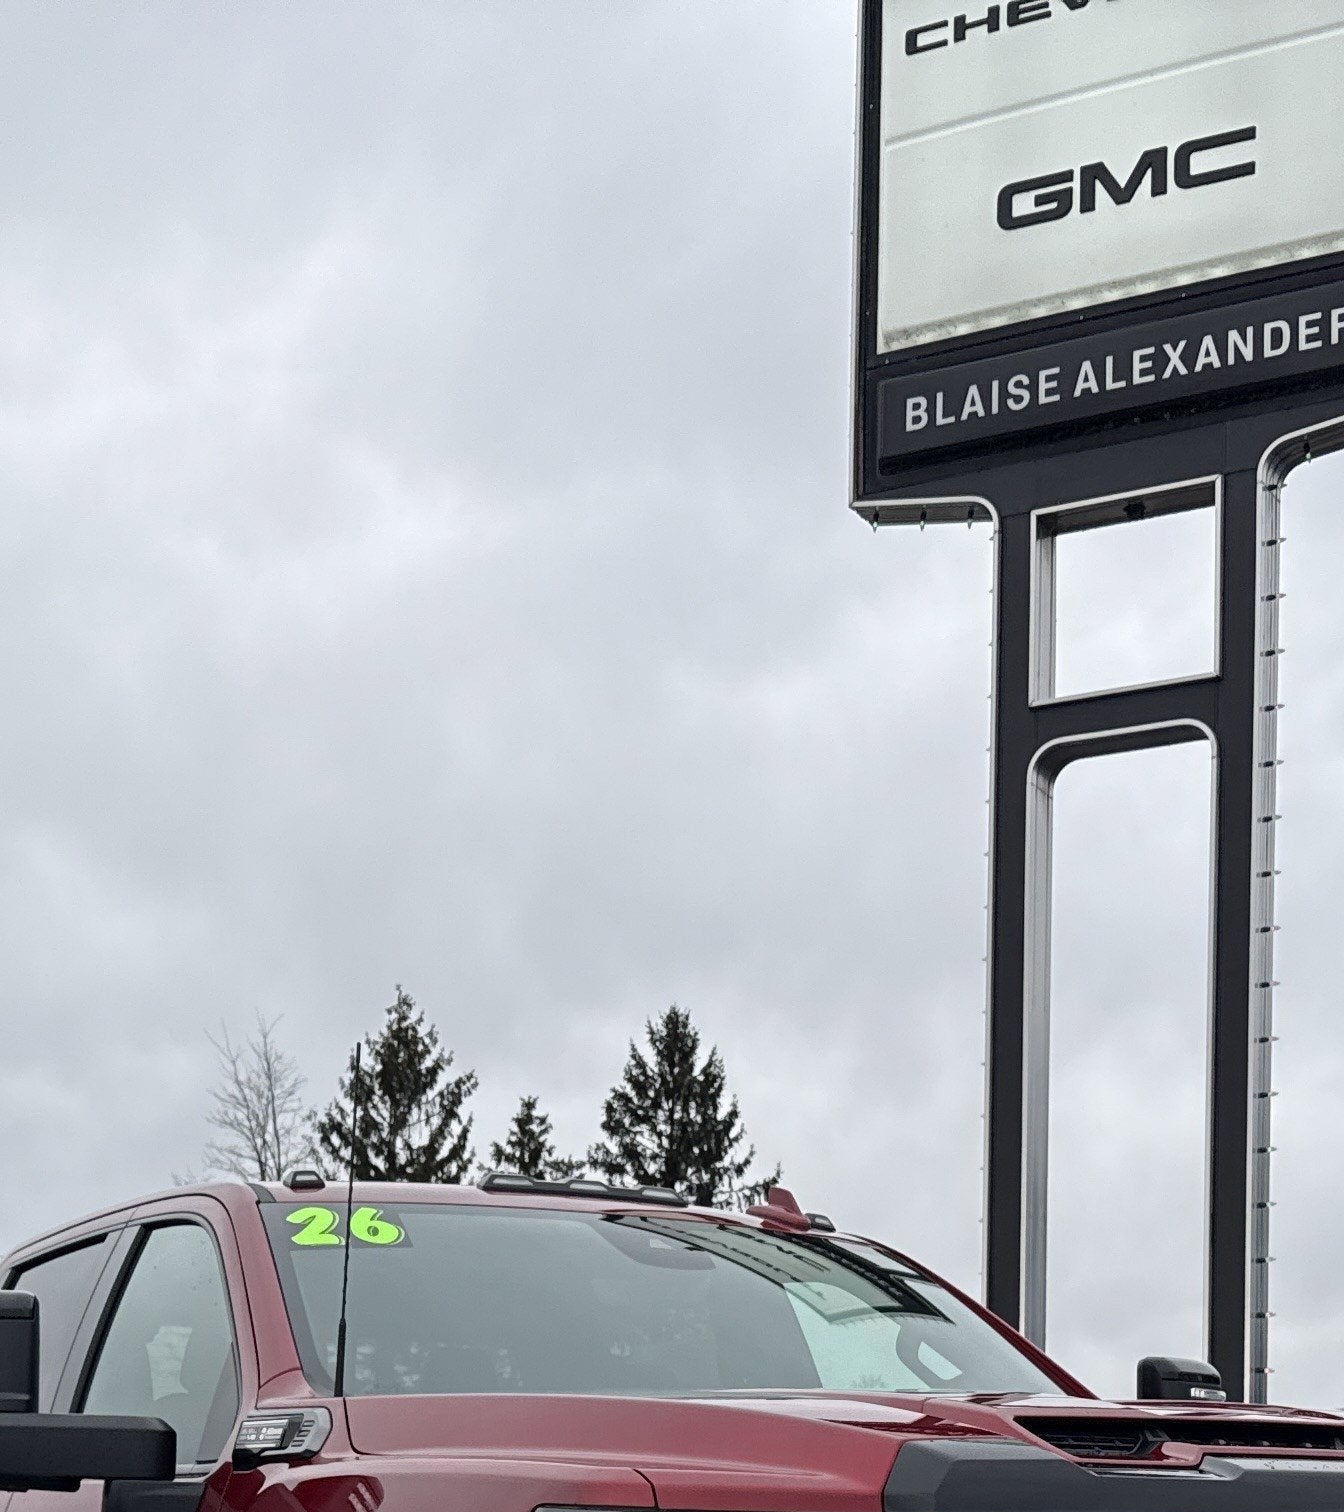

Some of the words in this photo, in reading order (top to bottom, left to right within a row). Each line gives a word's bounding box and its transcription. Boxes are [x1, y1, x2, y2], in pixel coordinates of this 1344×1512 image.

[997, 126, 1256, 230] GMC
[904, 366, 1062, 432] BLAISE
[285, 1206, 406, 1246] 26
